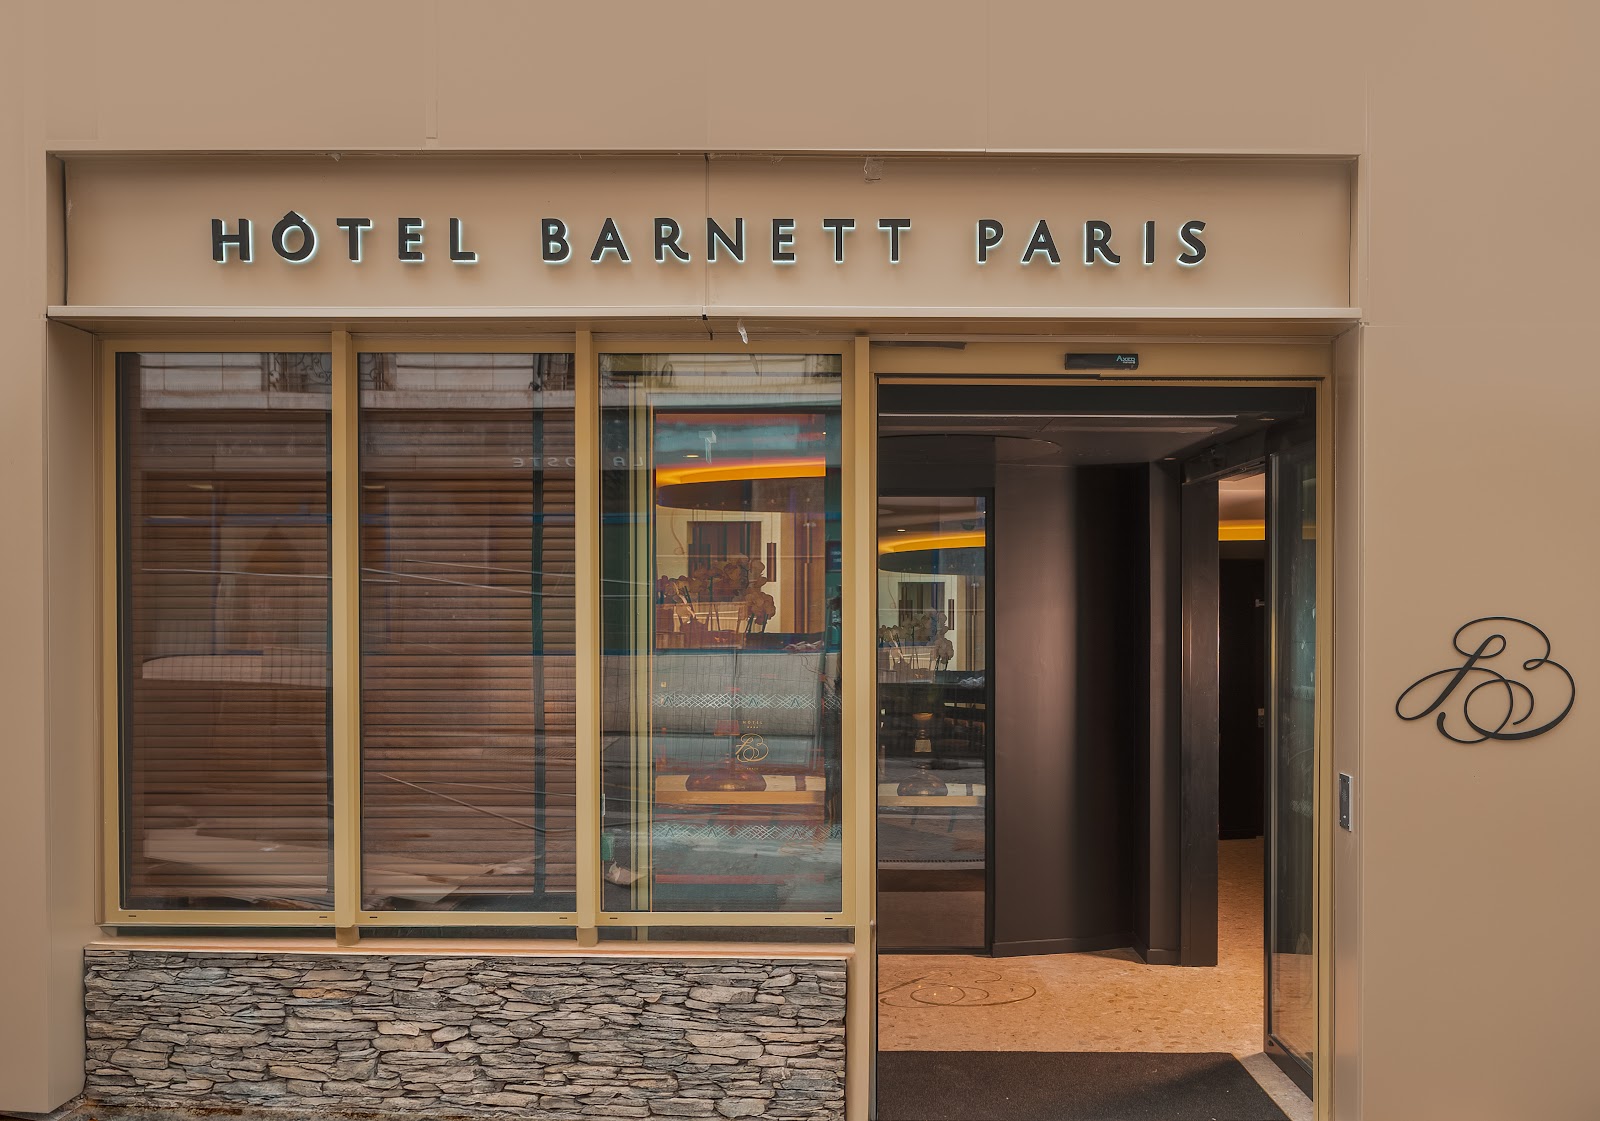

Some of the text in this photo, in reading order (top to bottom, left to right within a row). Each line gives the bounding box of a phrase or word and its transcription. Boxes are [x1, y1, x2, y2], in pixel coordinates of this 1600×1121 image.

[211, 210, 1207, 265] HÔTEL BARNETT PARIS
